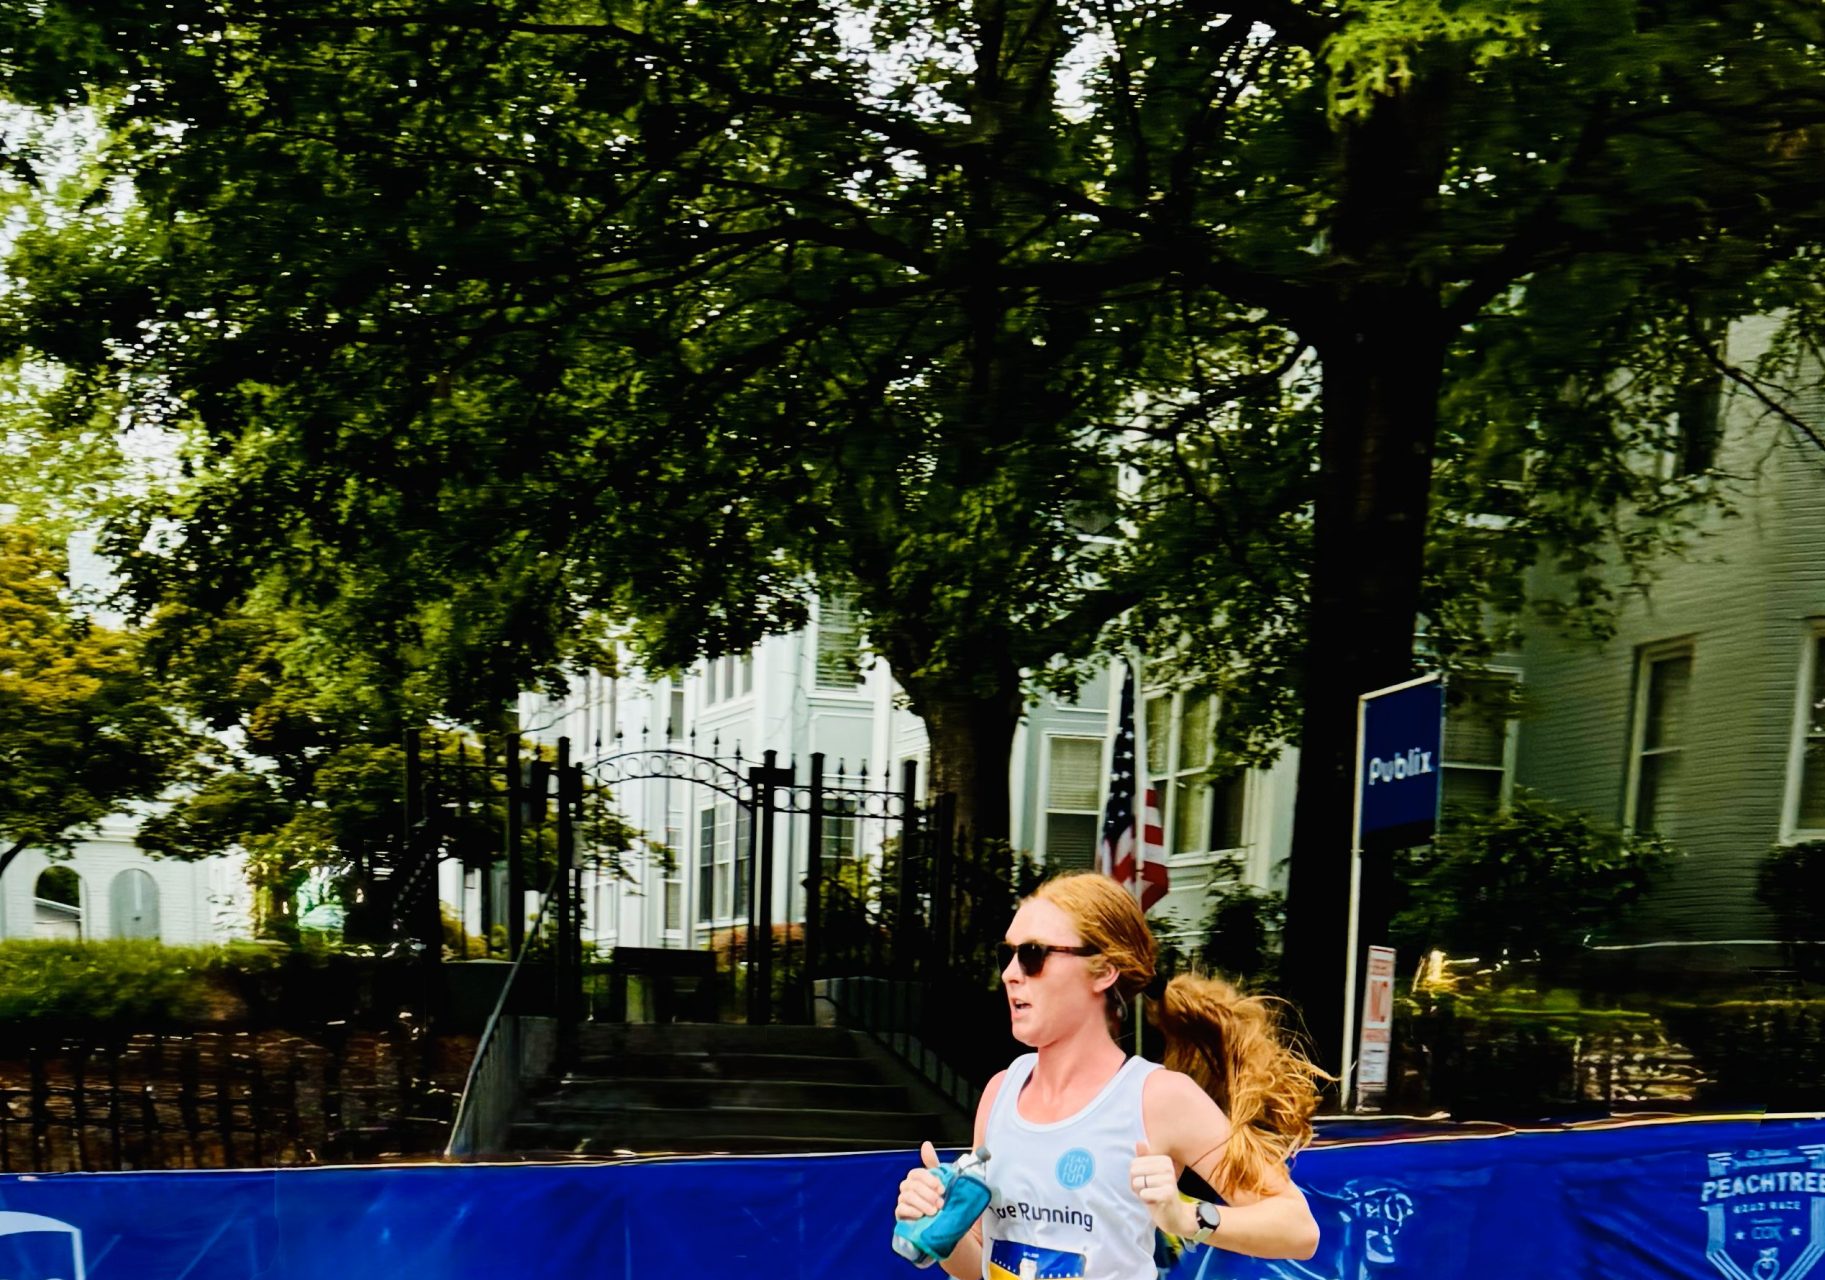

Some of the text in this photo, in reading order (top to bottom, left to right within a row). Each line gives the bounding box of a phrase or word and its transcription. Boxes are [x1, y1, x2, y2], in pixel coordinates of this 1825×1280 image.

[1369, 747, 1433, 785] Publix
[1062, 1172, 1084, 1184] run
[1064, 1163, 1086, 1174] run
[1018, 1202, 1093, 1232] Running
